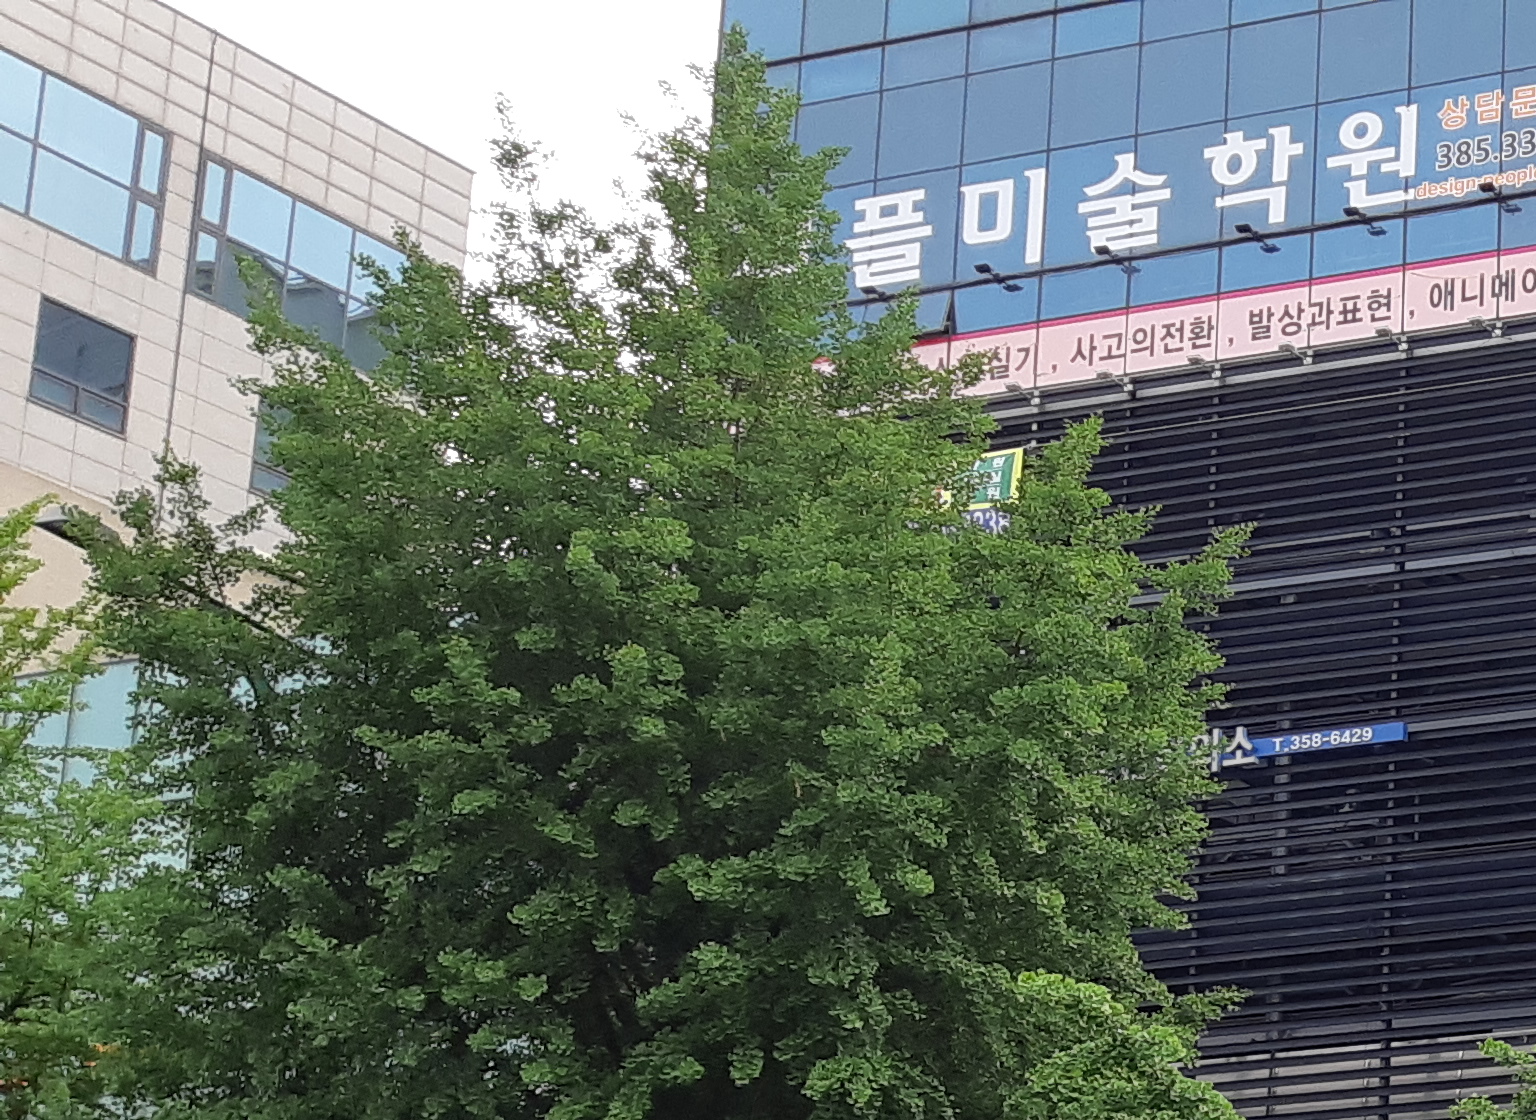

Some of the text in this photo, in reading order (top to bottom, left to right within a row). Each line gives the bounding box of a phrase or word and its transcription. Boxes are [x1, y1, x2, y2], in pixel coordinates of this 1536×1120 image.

[835, 103, 1420, 290] 플미술학원
[1069, 313, 1216, 368] 사고의전환
[1246, 283, 1394, 345] 발상과표현
[1272, 727, 1374, 753] T.358-6429
